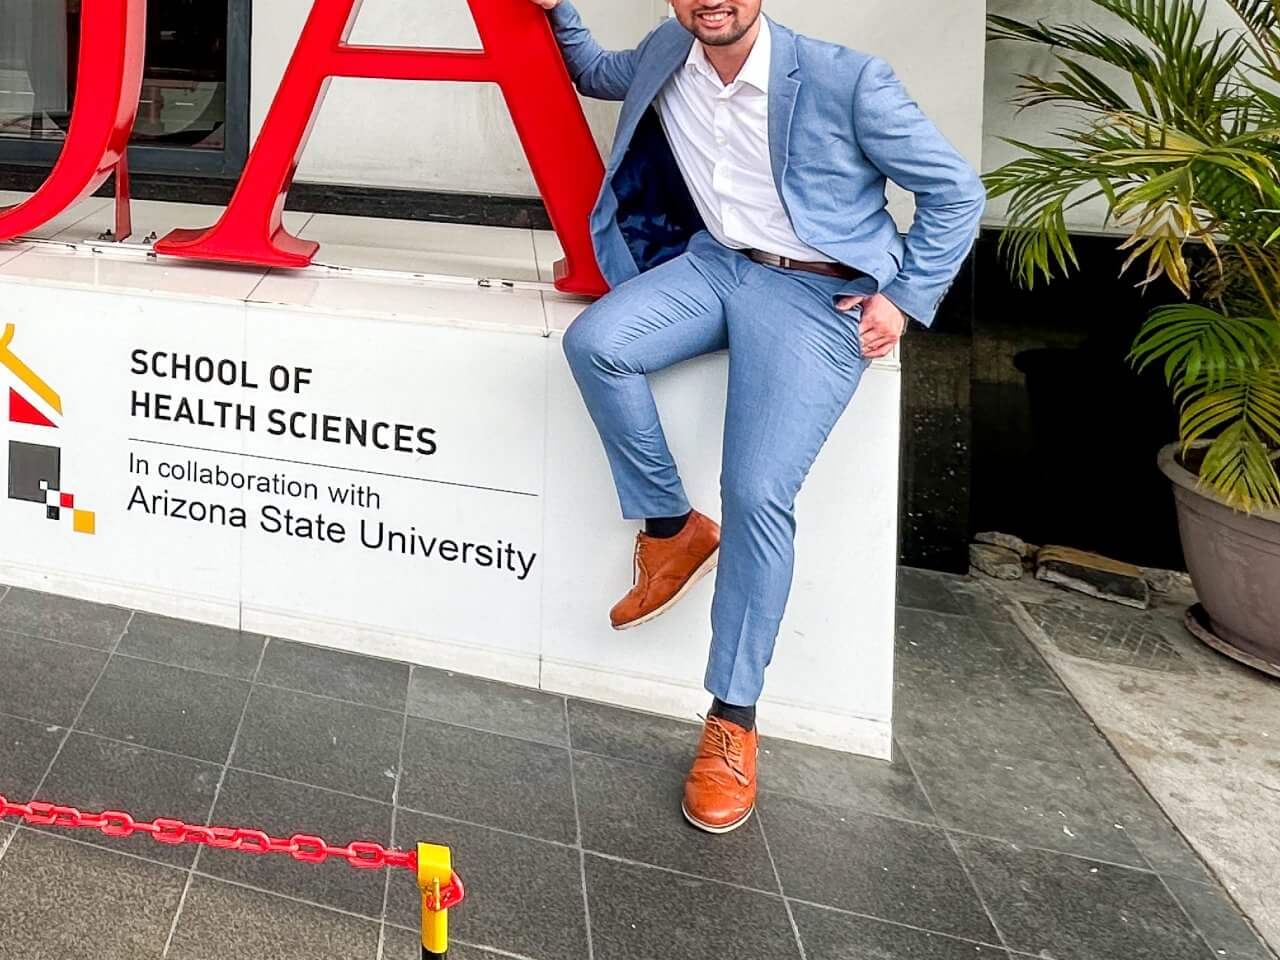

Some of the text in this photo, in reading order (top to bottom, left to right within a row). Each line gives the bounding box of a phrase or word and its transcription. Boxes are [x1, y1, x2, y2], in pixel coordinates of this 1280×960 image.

[130, 349, 312, 393] SCHOOL OF
[131, 391, 438, 456] HEALTH SCIENCES
[129, 452, 381, 509] In collaboration with
[127, 485, 536, 580] Arizona State University
